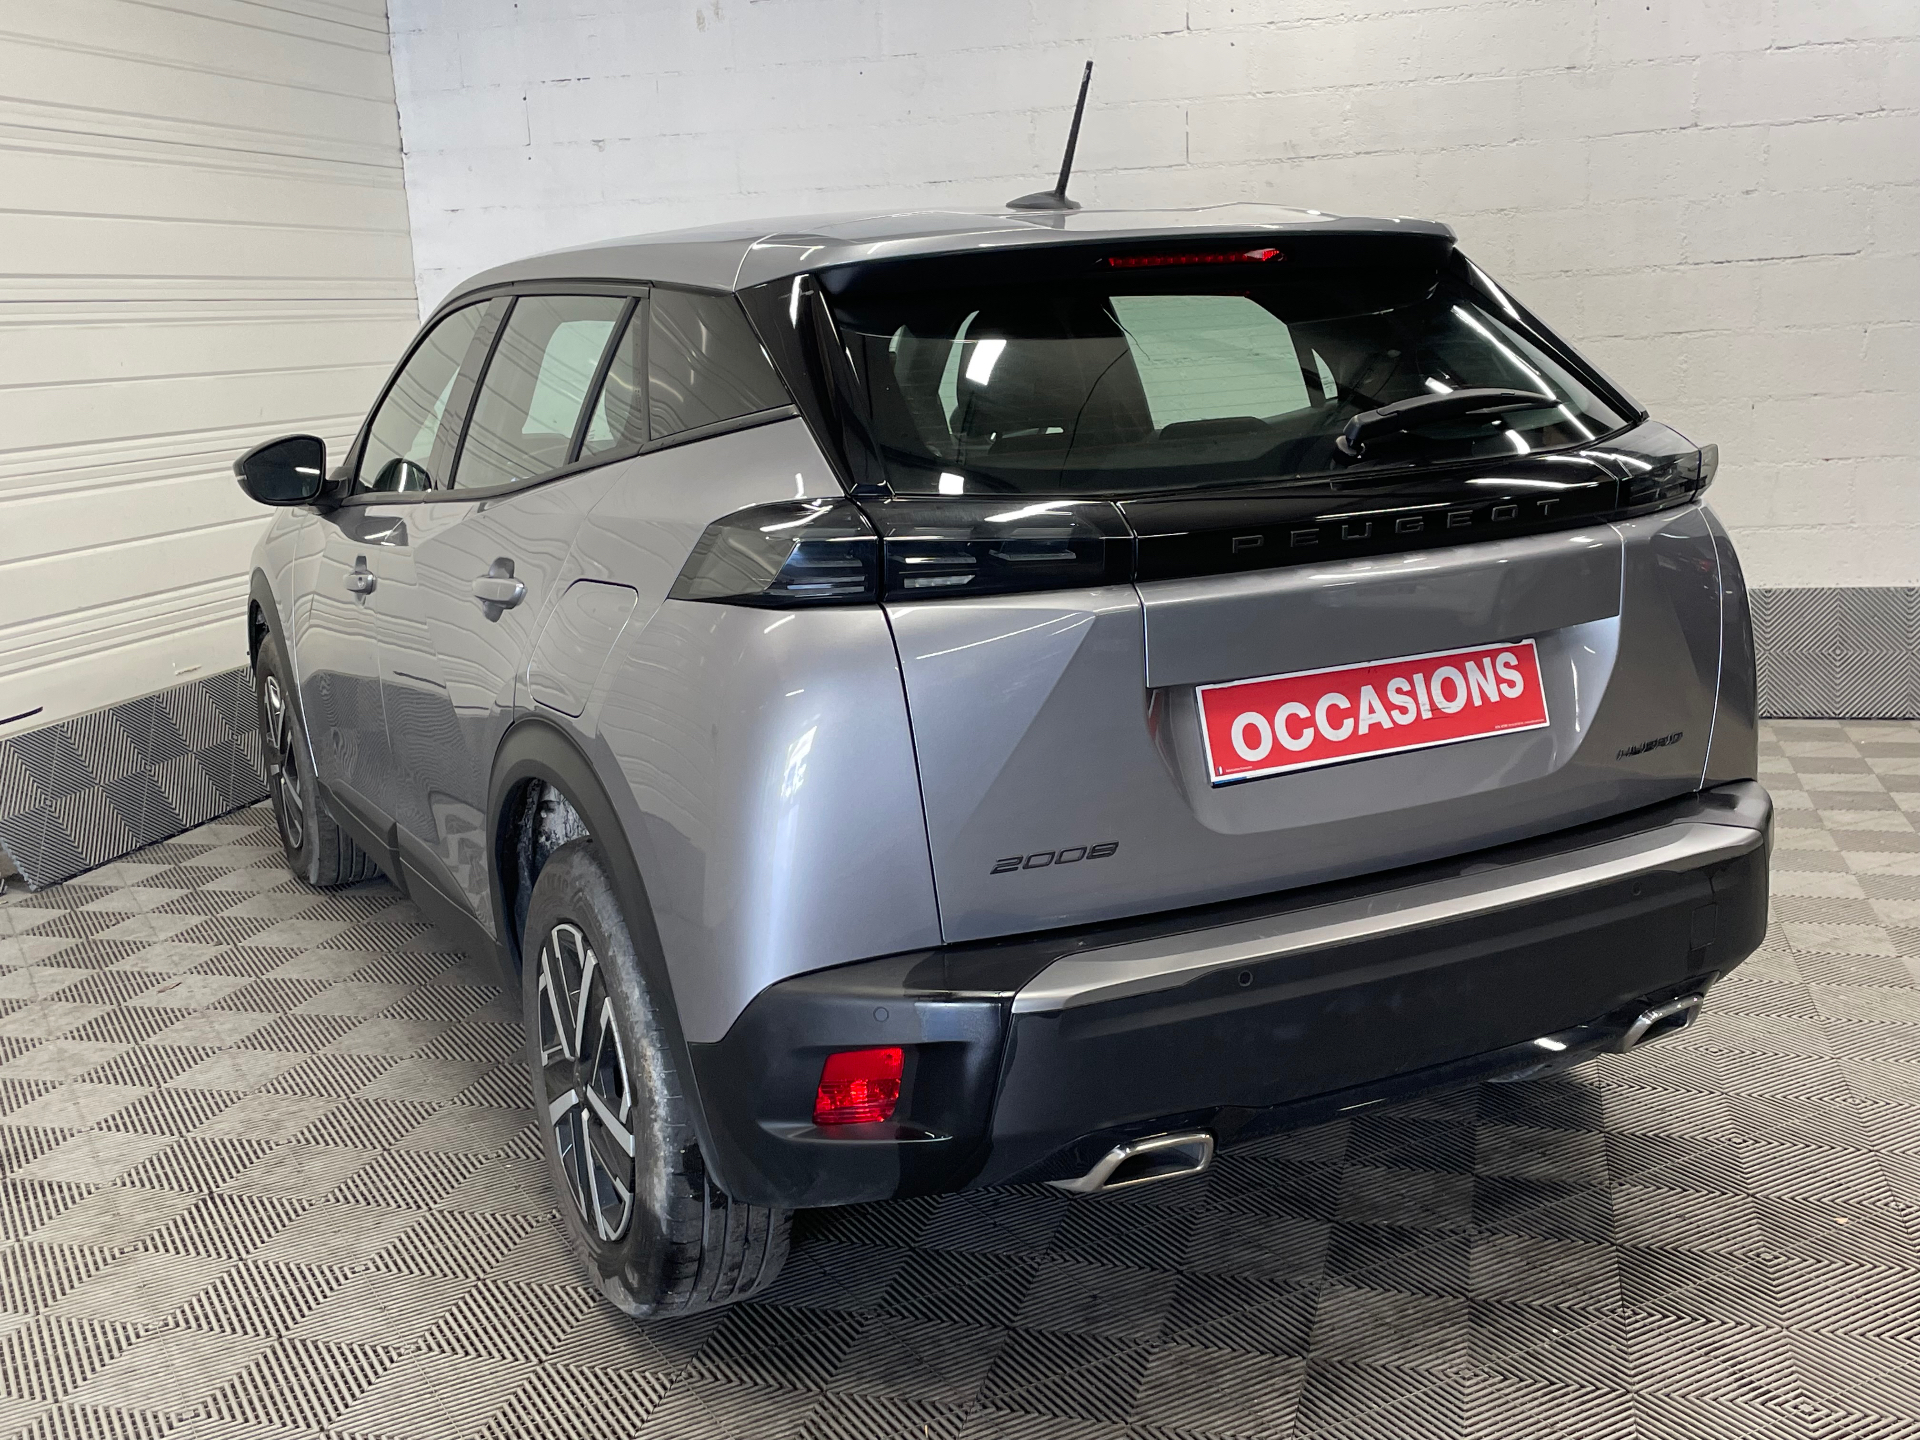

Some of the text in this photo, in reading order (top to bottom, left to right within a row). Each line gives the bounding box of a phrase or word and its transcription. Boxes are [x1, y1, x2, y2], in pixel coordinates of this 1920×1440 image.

[1232, 498, 1560, 554] PEUGEOT
[1230, 651, 1525, 762] OCCASIONS
[990, 840, 1120, 875] 2008
